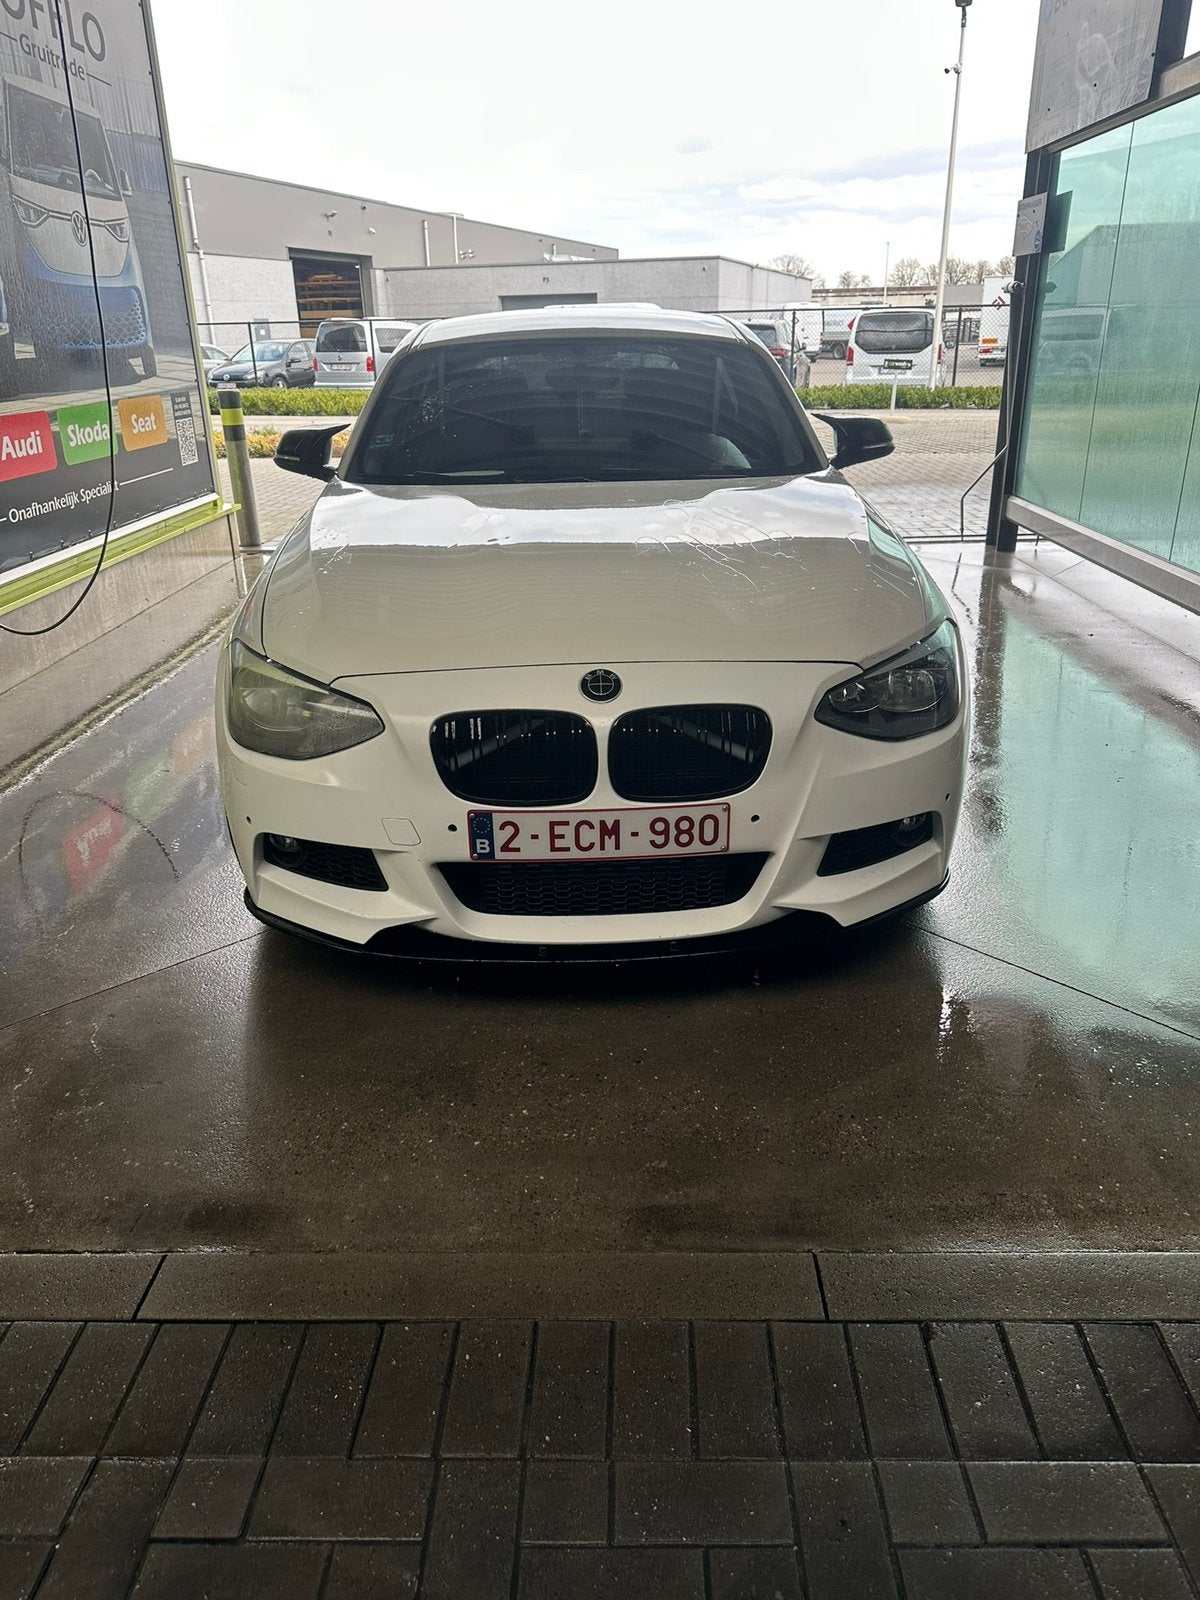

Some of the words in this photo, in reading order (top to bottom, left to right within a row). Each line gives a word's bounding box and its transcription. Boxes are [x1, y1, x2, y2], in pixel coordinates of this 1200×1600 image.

[67, 420, 110, 447] Skoda
[131, 412, 157, 434] Seat
[1, 430, 43, 461] Audi
[8, 492, 80, 523] Onafhankelijk
[80, 479, 120, 504] Specialit
[475, 838, 491, 854] B
[498, 813, 720, 853] 2-ECM-980
